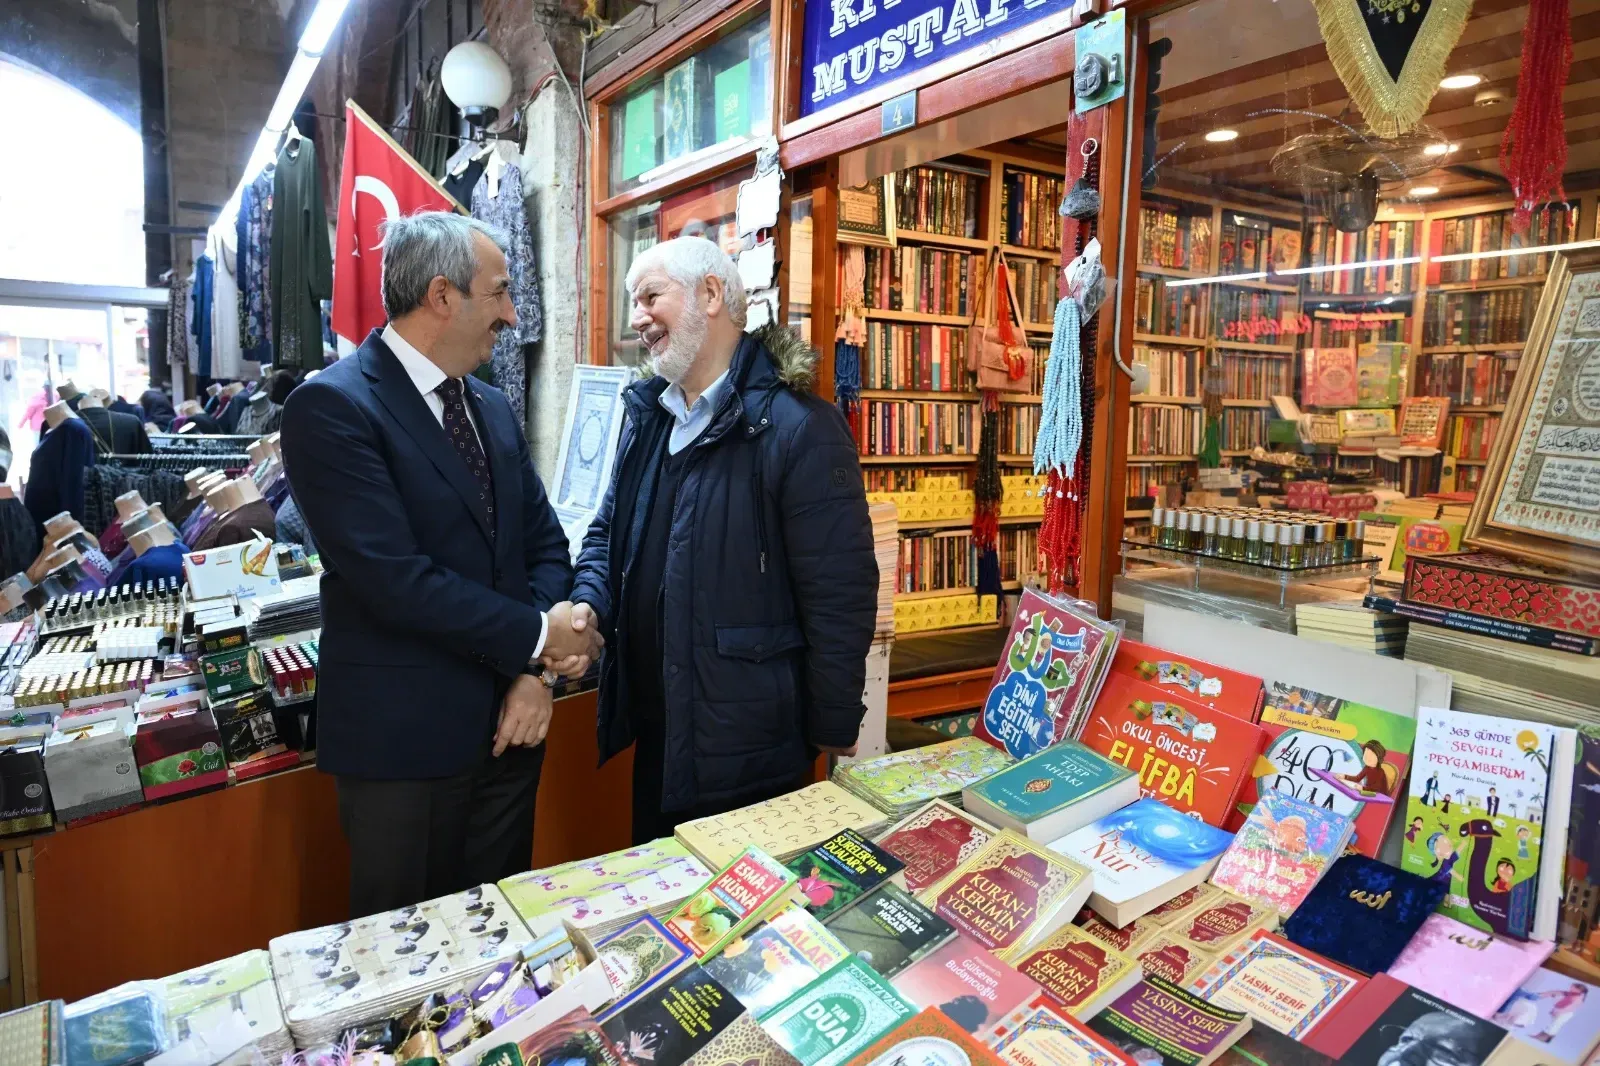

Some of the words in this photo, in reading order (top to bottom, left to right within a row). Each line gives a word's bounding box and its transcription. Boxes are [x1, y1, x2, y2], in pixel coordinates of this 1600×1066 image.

[892, 104, 902, 126] 4
[997, 694, 1041, 742] EĞİTİM
[999, 720, 1022, 749] SETİ
[1449, 727, 1470, 738] 365
[1474, 729, 1512, 744] GÜNDE
[1122, 721, 1152, 743] OKUL
[1156, 732, 1206, 766] ÖNCESİ
[1276, 736, 1333, 782] 40
[1060, 760, 1090, 777] EDEP
[1080, 840, 1139, 873] Nur
[1099, 829, 1165, 868] Beyaz
[734, 861, 778, 896] ESMÂ-İ
[874, 863, 887, 874] ve
[1001, 864, 1022, 880] HAMDİ
[1022, 876, 1039, 889] YAZIR
[717, 874, 760, 911] HÜSNÂ
[957, 884, 1021, 931] KERÎM'İN
[969, 873, 1033, 919] KUR'ÂN-I
[878, 910, 908, 933] HOCASI
[895, 911, 924, 935] NAMAZ
[946, 894, 976, 920] YÜCE
[972, 914, 1009, 942] MEÂLİ
[945, 959, 998, 1001] Budayıcıoğlu
[962, 959, 998, 987] Gülseren
[1025, 966, 1050, 983] YÜCE
[1042, 952, 1095, 988] KUR'ÂN-I
[831, 1003, 851, 1023] TAM
[1229, 985, 1258, 1005] SEÇME
[1257, 1002, 1295, 1024] DUALAR
[802, 1001, 848, 1045] DUA
